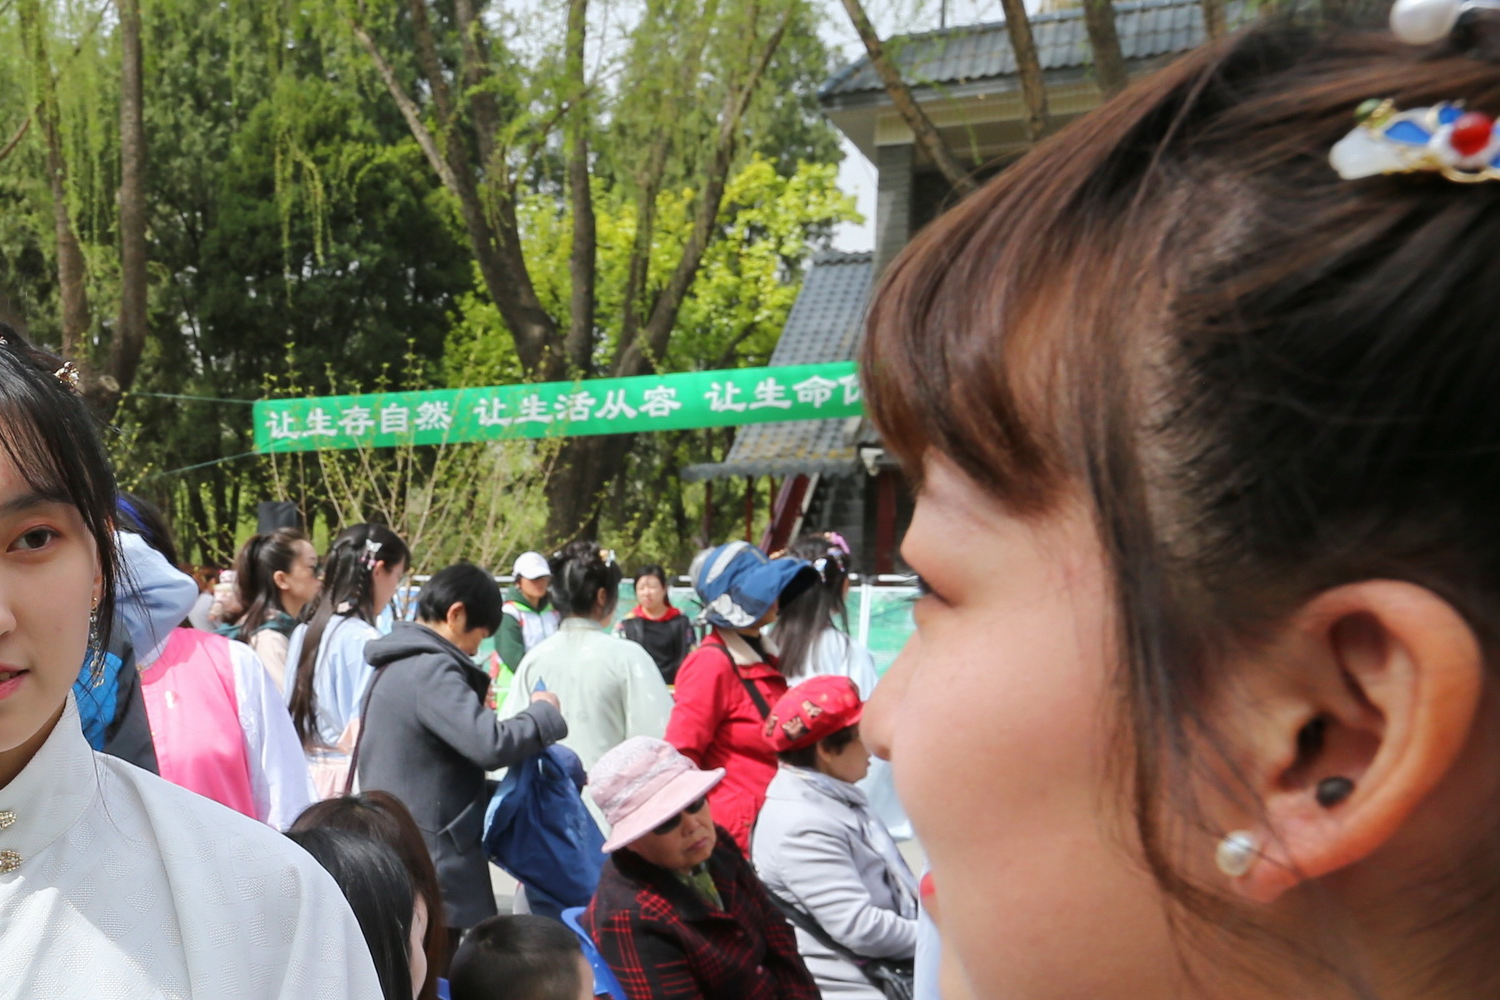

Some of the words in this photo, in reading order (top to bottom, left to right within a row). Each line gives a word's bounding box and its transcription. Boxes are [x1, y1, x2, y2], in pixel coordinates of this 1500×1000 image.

[265, 401, 453, 439] 让生存自然
[473, 385, 682, 427] 让生活从容
